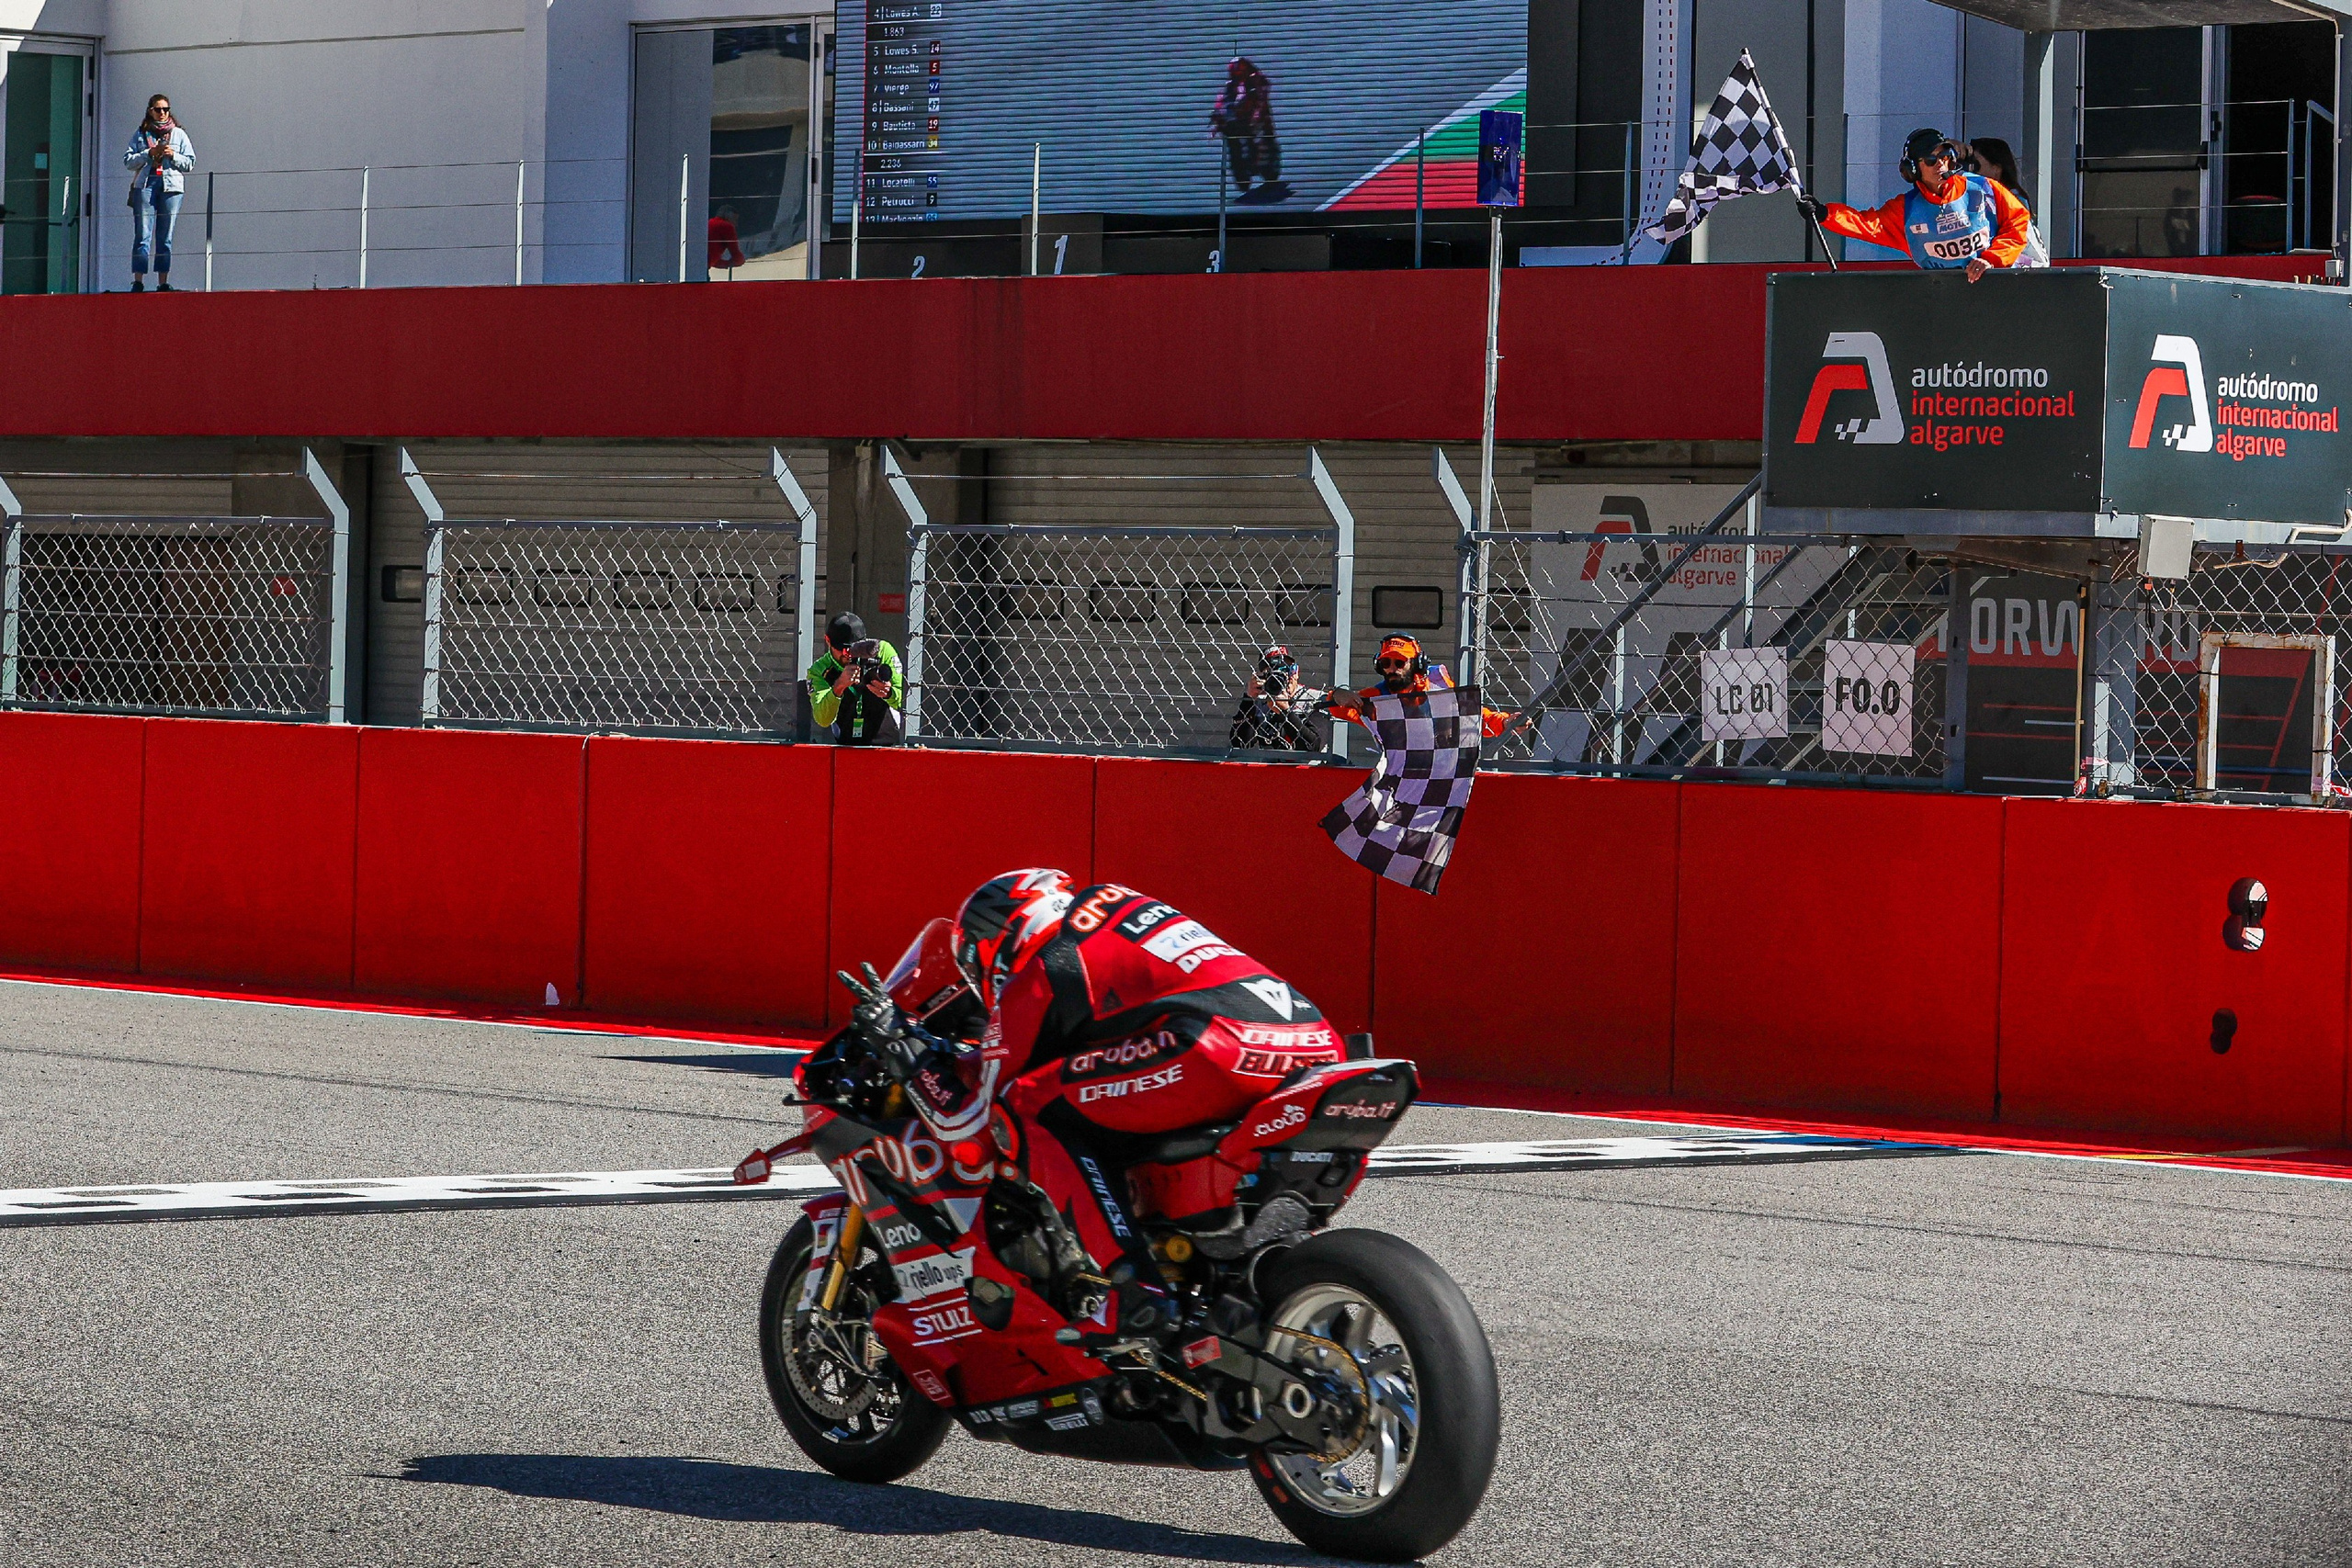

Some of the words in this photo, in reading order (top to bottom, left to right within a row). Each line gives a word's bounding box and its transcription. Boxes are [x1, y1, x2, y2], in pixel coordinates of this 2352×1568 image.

[873, 46, 879, 56] 5
[884, 45, 910, 56] Lowes
[932, 62, 938, 72] 5
[871, 121, 877, 131] 9
[883, 119, 916, 131] Bautista
[929, 119, 938, 129] 19
[867, 141, 877, 151] 10
[928, 176, 937, 186] 55
[865, 197, 876, 207] 12
[1054, 235, 1069, 275] 1
[1933, 232, 1984, 258] 0032
[910, 255, 926, 279] 2
[1205, 250, 1220, 273] 3
[1911, 360, 2049, 388] autódromo
[2217, 371, 2320, 403] autódromo
[1911, 389, 2075, 417] internacional
[2217, 398, 2340, 433] internacional
[1909, 419, 2005, 452] algarve
[2216, 427, 2288, 461] algarve
[1716, 685, 1742, 716] LC
[1241, 1029, 1333, 1048] DAINESE
[1079, 1064, 1184, 1103] DAINESE
[1080, 1156, 1133, 1237] DAINESE
[912, 1305, 976, 1337] STULZ
